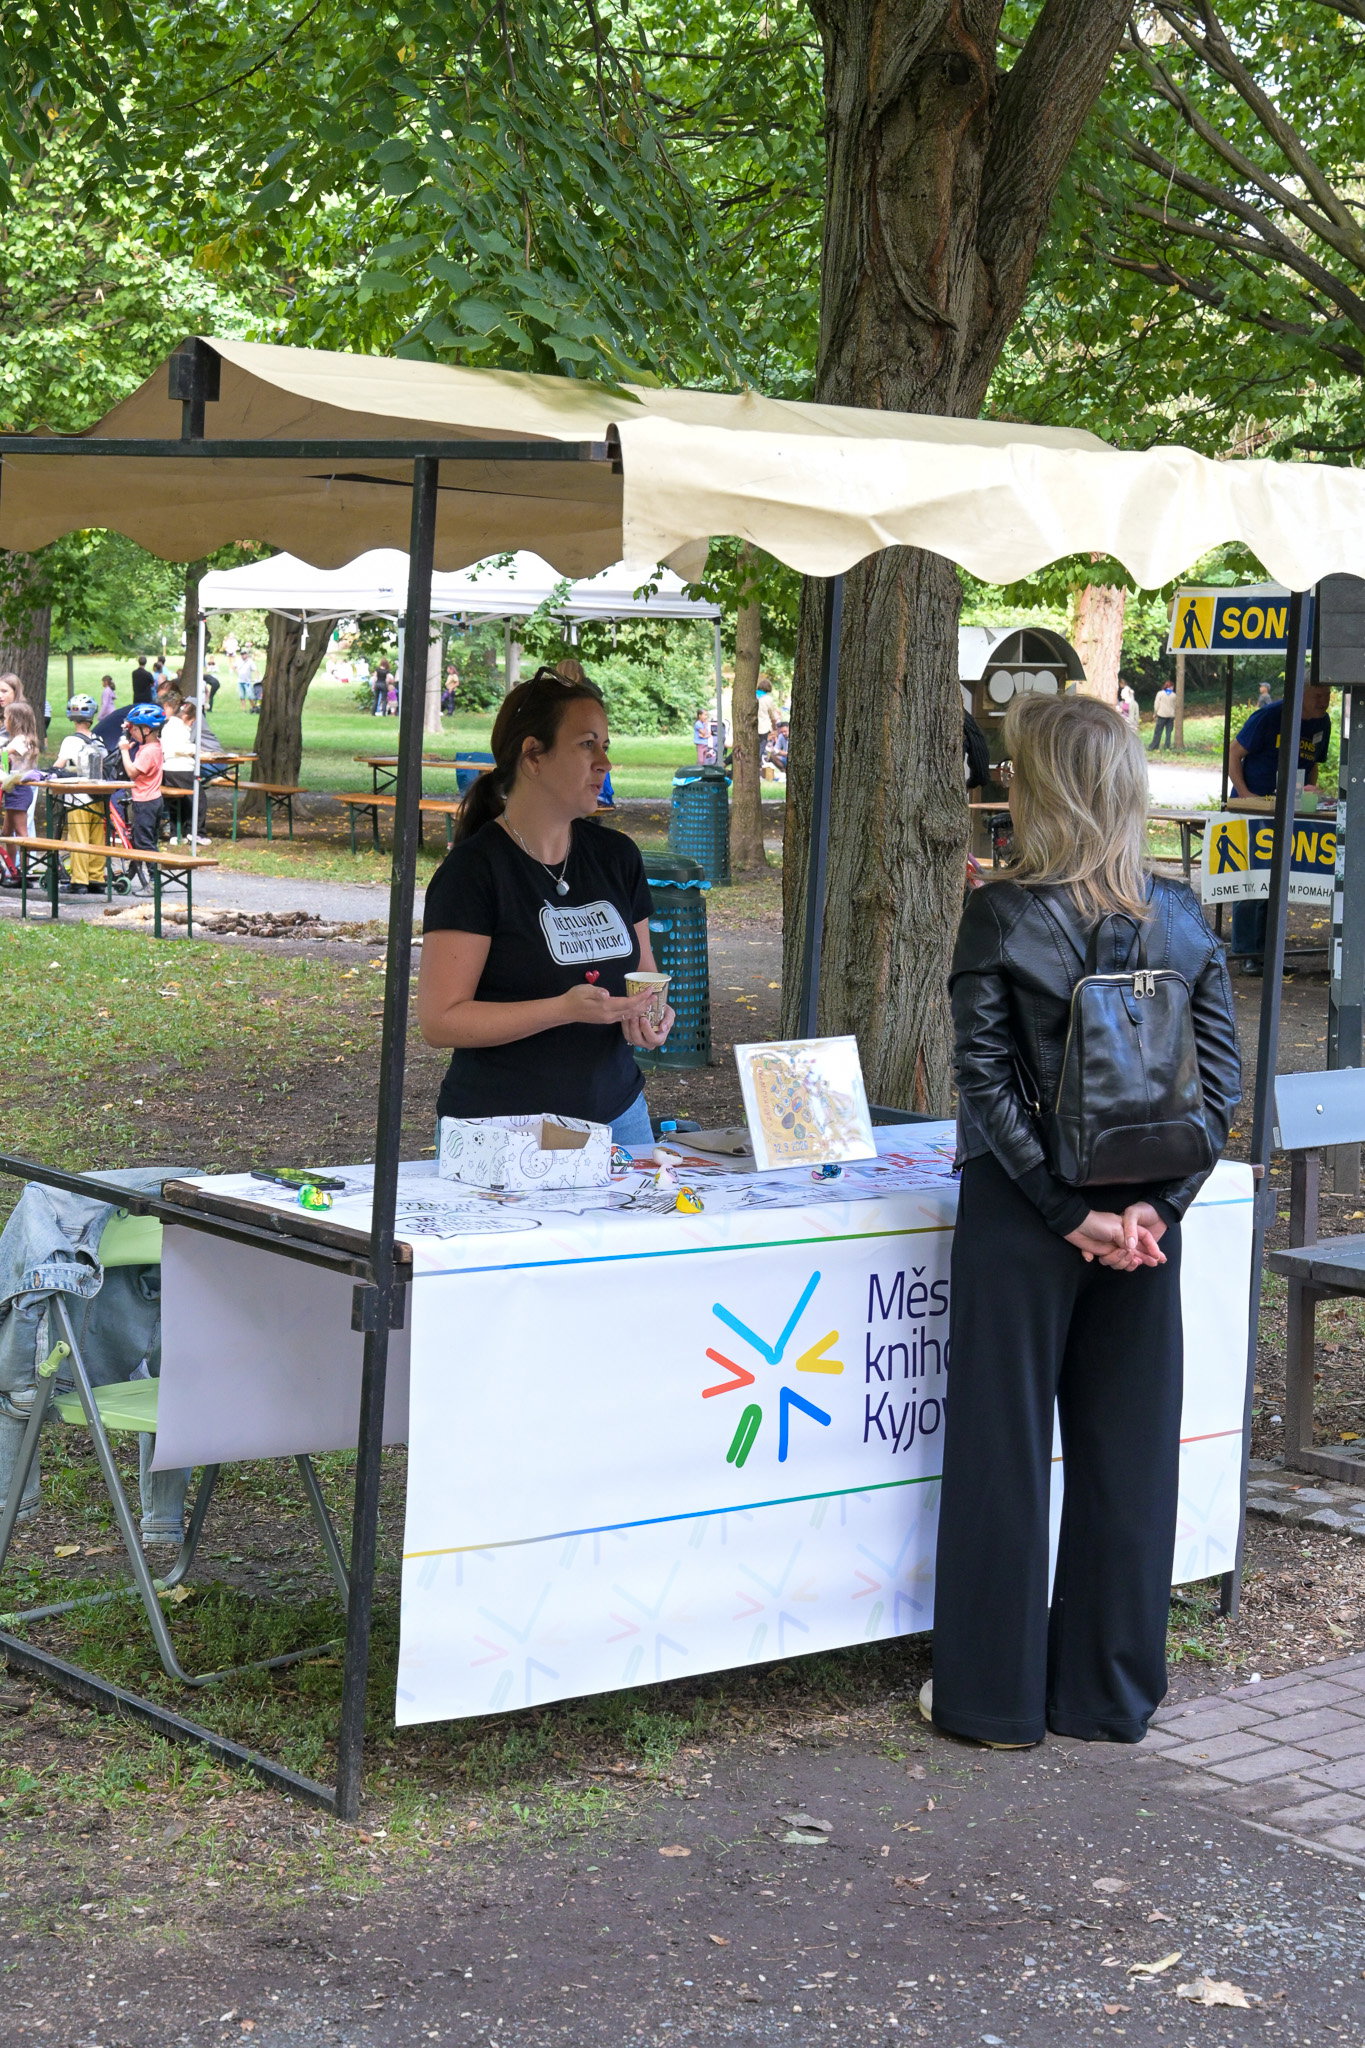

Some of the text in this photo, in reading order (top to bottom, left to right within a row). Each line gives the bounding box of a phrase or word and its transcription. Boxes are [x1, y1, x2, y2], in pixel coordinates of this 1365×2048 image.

[1219, 606, 1290, 640] SON
[1254, 827, 1337, 866] SNS
[1211, 884, 1240, 897] JSME
[552, 911, 609, 931] NEMLUVÍM
[560, 932, 627, 955] MLUVIT NECHCI
[865, 1325, 950, 1384] knih
